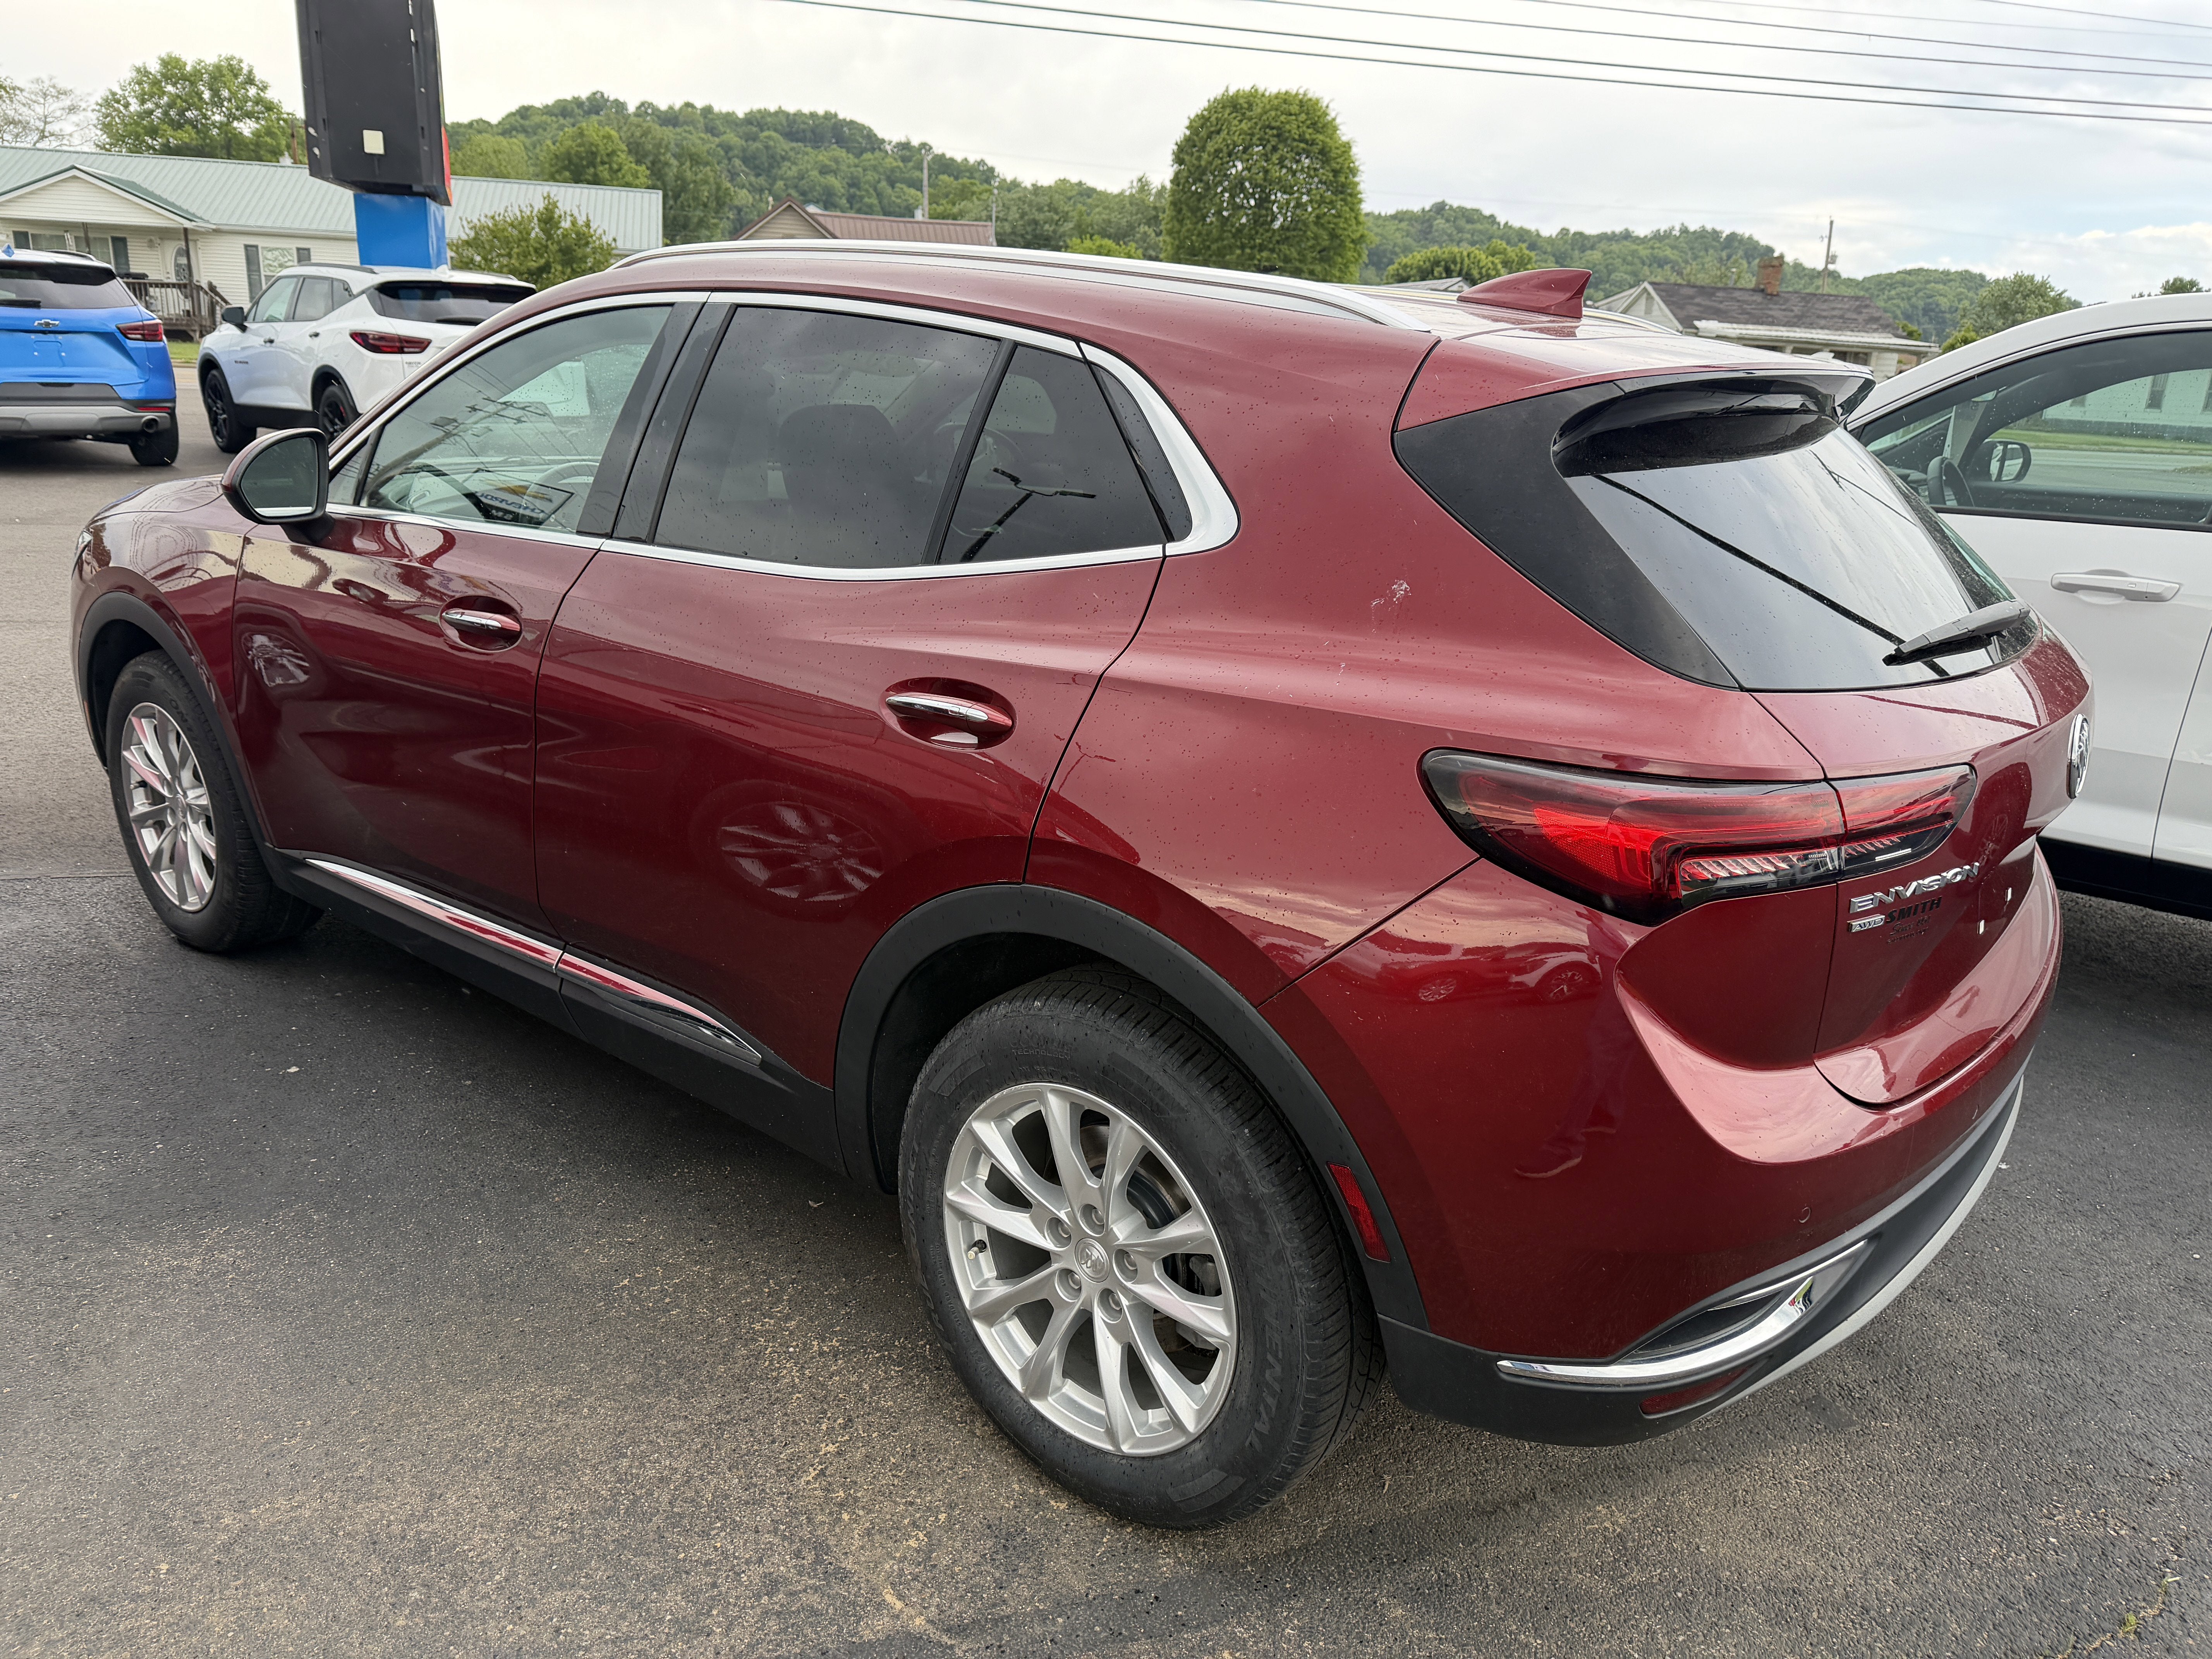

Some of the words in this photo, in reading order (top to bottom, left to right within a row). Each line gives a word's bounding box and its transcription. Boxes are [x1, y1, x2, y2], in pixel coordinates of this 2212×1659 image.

[1850, 862, 1980, 914] ENVISION
[1852, 918, 1884, 932] AWD
[1886, 896, 1942, 924] SMITH
[1012, 1049, 1071, 1060] TECHNOLOGY
[944, 1291, 962, 1326] STANDARD
[1200, 1149, 1282, 1453] CONTINENTAL
